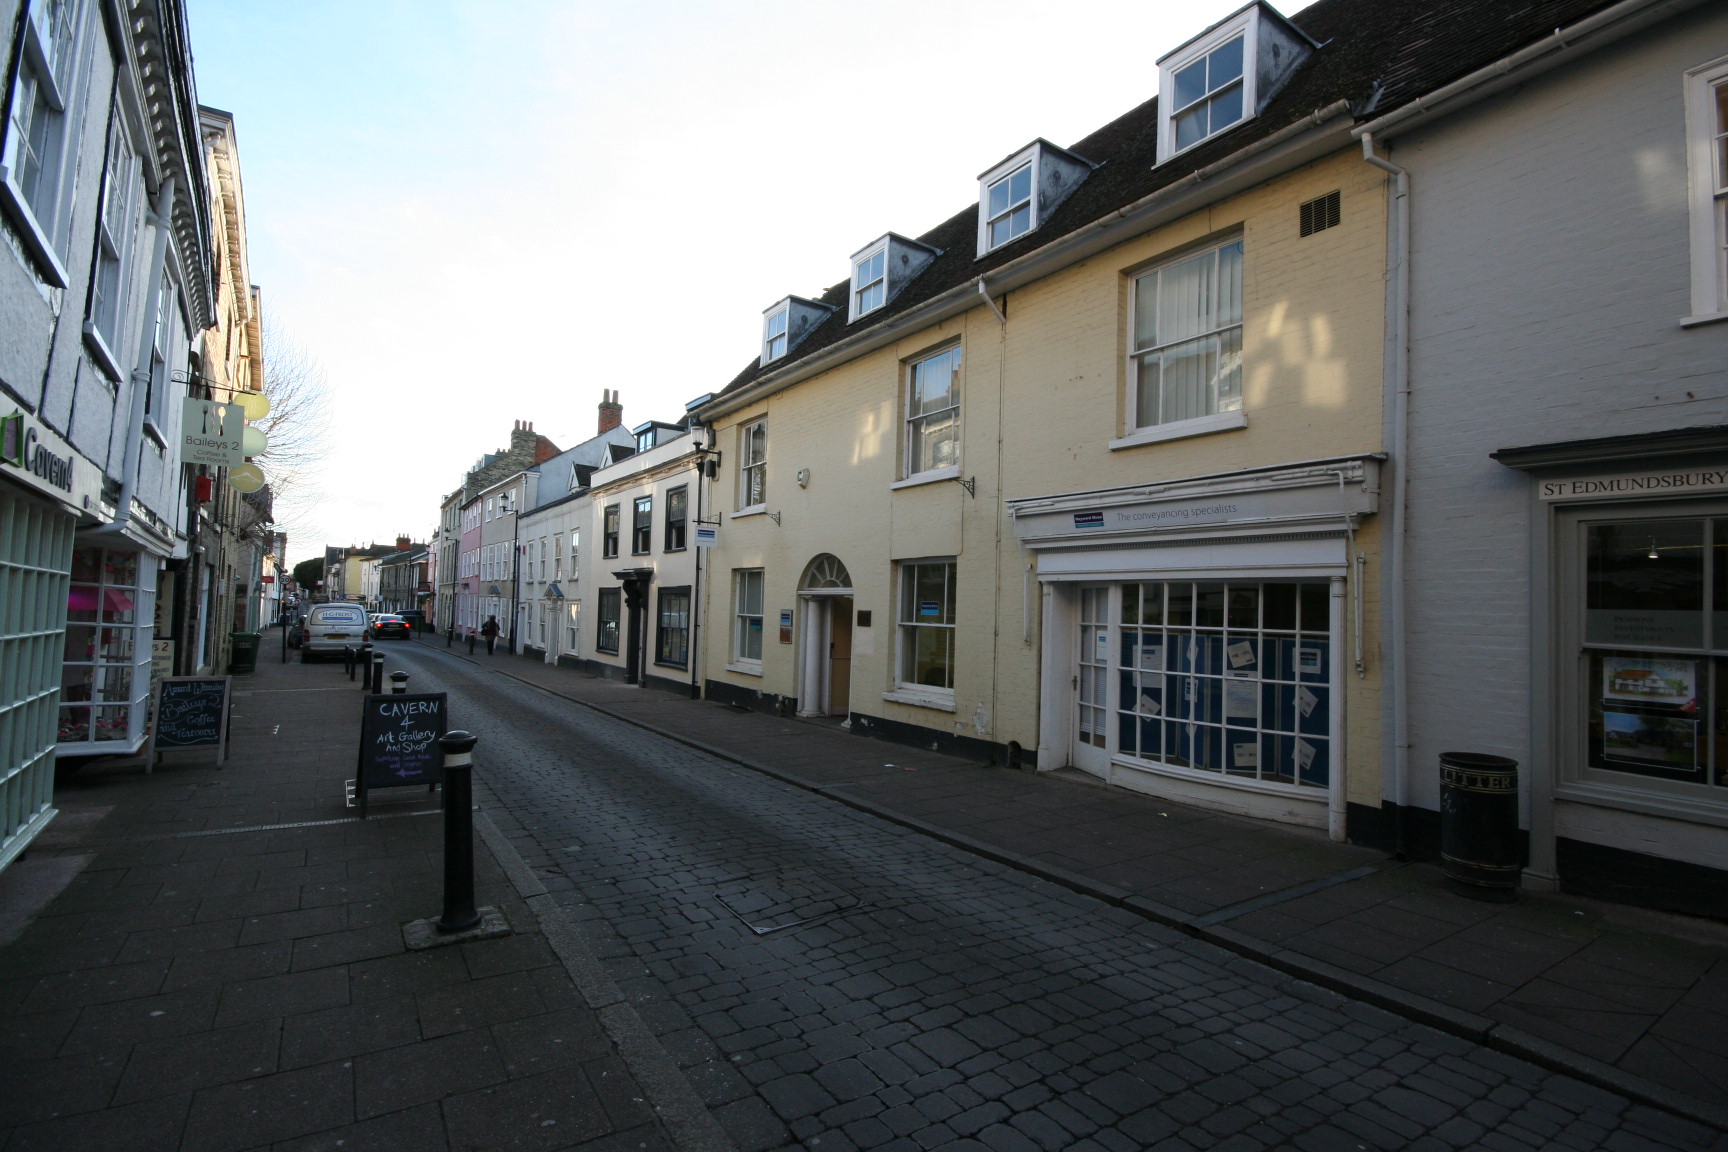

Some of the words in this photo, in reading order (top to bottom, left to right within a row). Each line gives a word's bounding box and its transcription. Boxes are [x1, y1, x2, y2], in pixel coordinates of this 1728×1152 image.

[186, 435, 228, 450] Baileys
[232, 441, 239, 451] 2
[197, 449, 220, 457] Coffee
[207, 456, 230, 464] Rooms
[1572, 471, 1728, 494] EDMUNDSBURY
[1117, 512, 1131, 522] The
[1132, 509, 1189, 520] conveyancing
[1191, 504, 1237, 518] specialists
[161, 641, 169, 651] 2
[163, 683, 191, 696] Award
[208, 695, 221, 709] 2
[379, 701, 439, 717] CAVERN
[186, 713, 215, 726] Coffee
[400, 714, 416, 731] 4
[377, 731, 395, 744] Art
[398, 730, 436, 743] Gallery
[386, 743, 401, 752] And
[402, 741, 427, 753] Shop
[1443, 769, 1512, 789] LITTER
